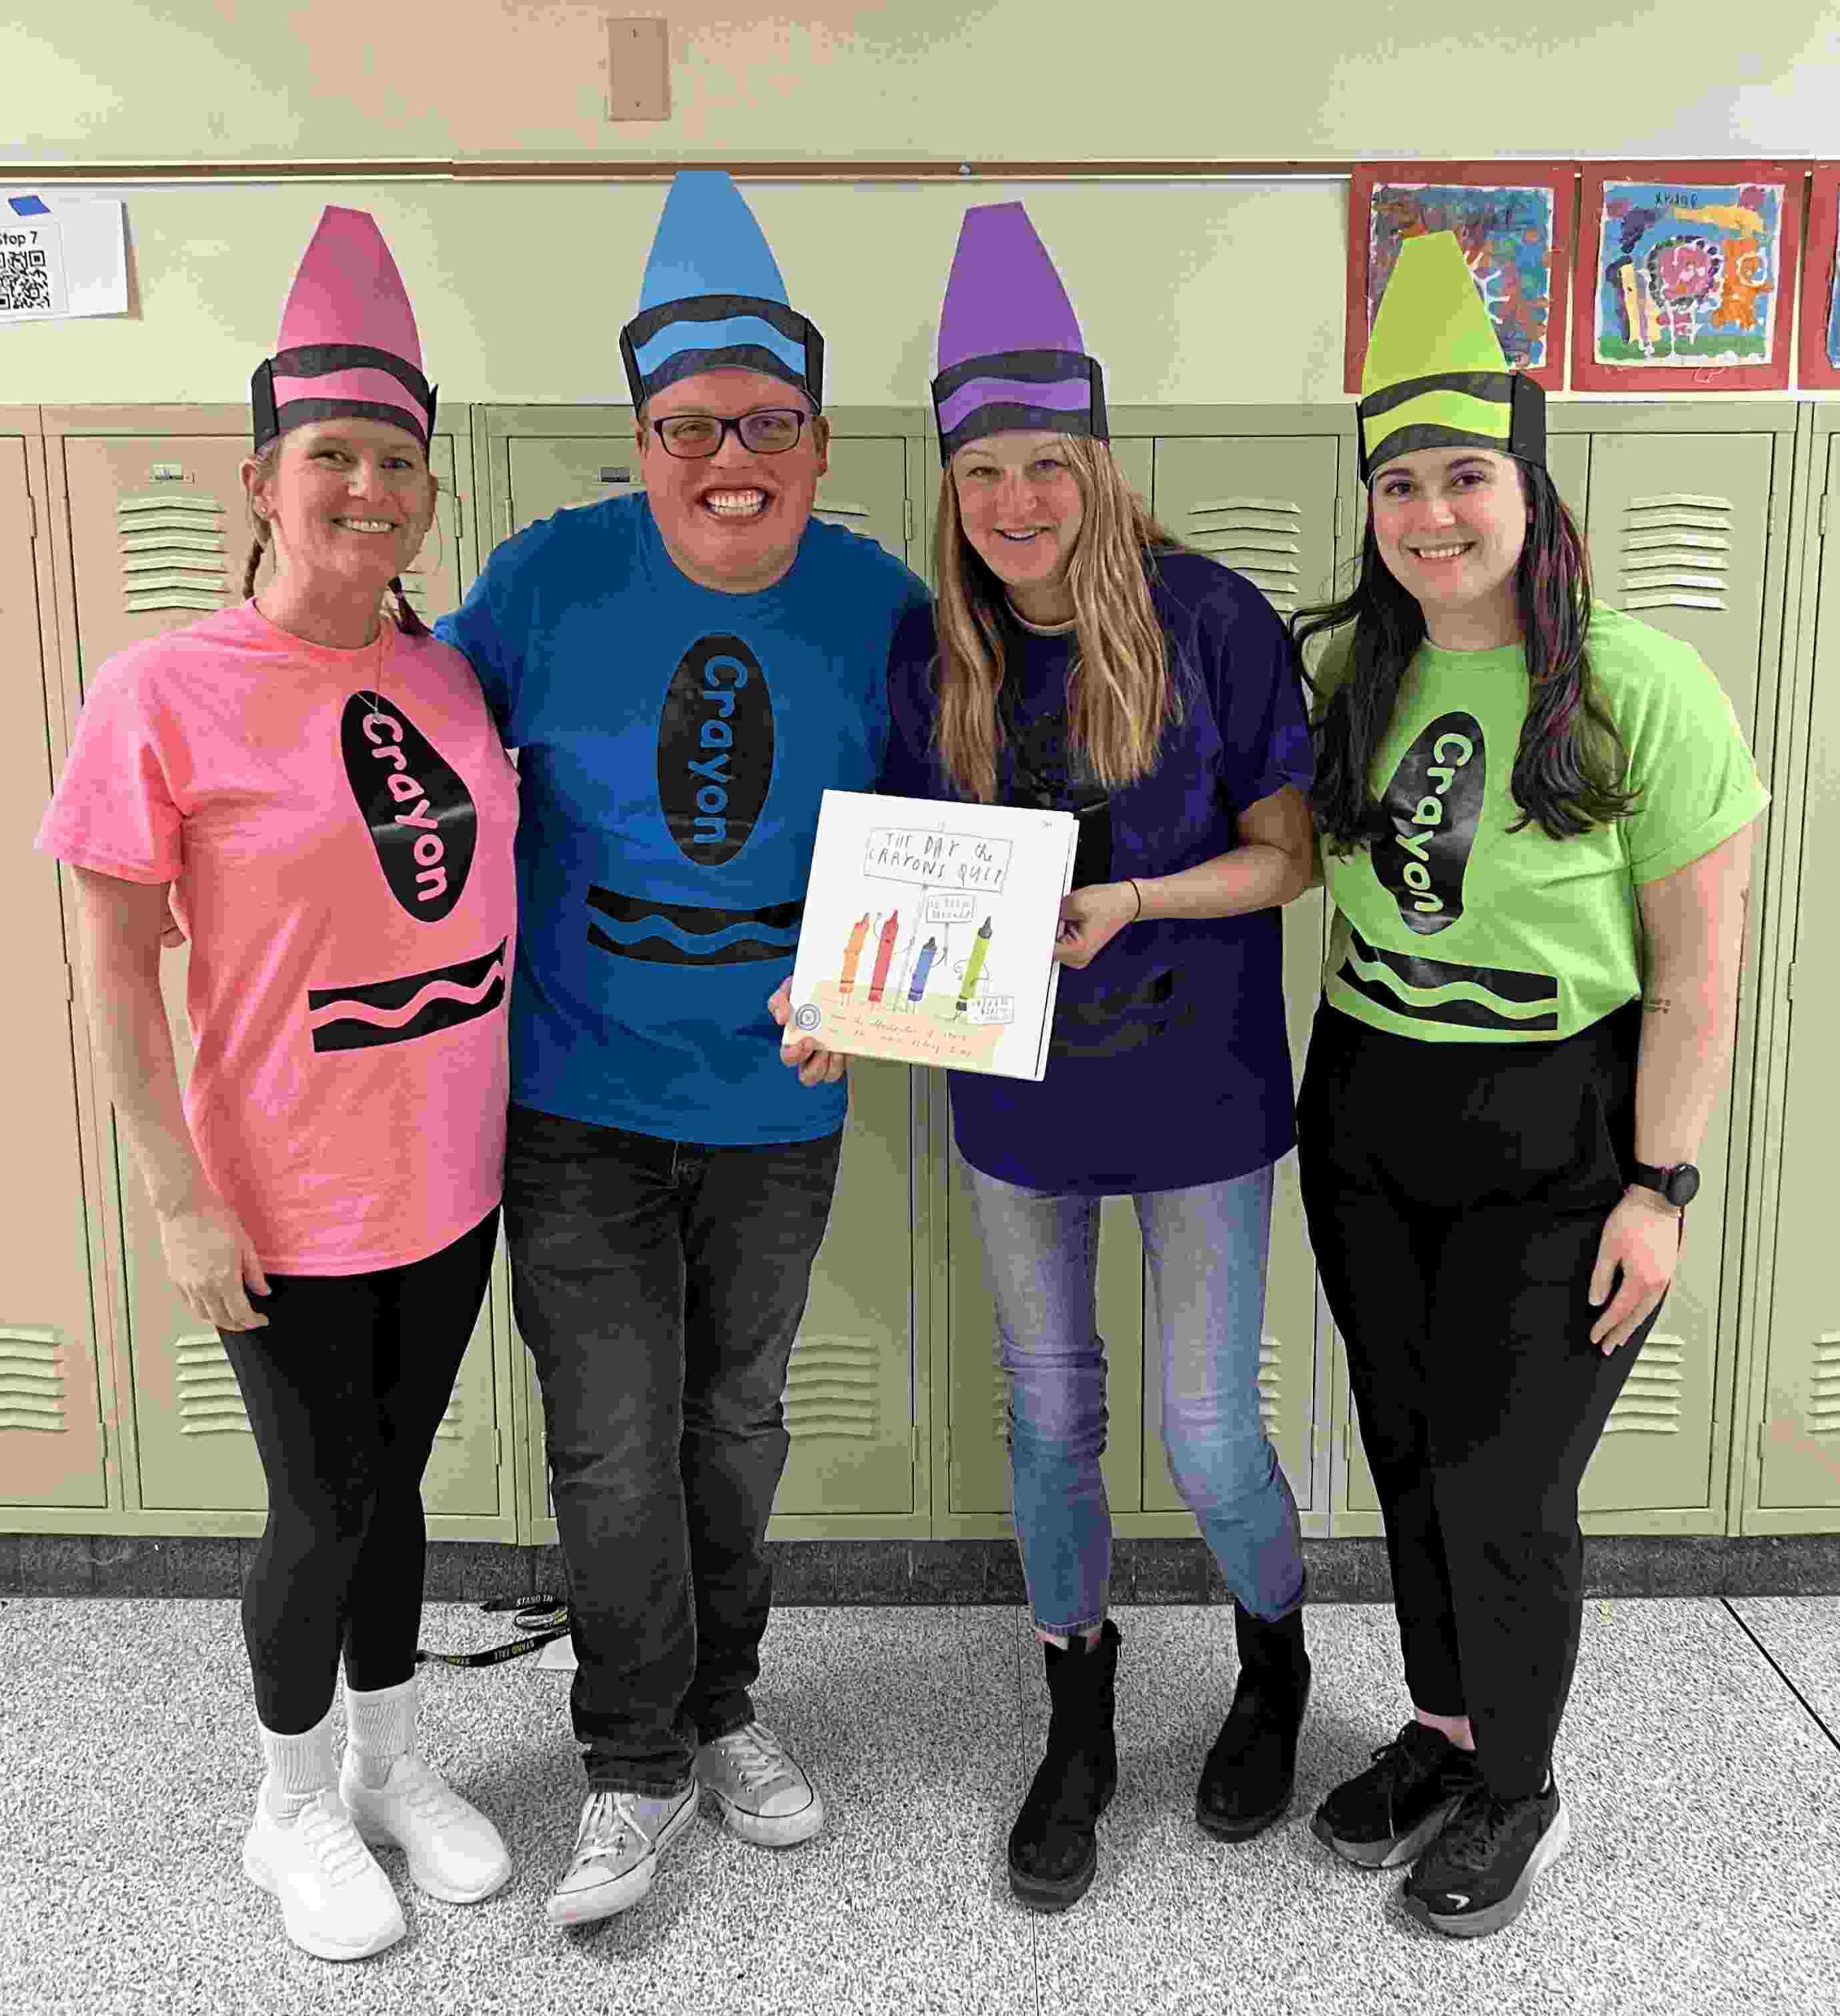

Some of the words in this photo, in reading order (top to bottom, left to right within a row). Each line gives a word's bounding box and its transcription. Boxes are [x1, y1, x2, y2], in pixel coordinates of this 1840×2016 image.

[30, 231, 38, 244] 7
[362, 713, 447, 902] Crayon
[687, 654, 748, 843] Crayon
[1394, 732, 1474, 913] Crayon
